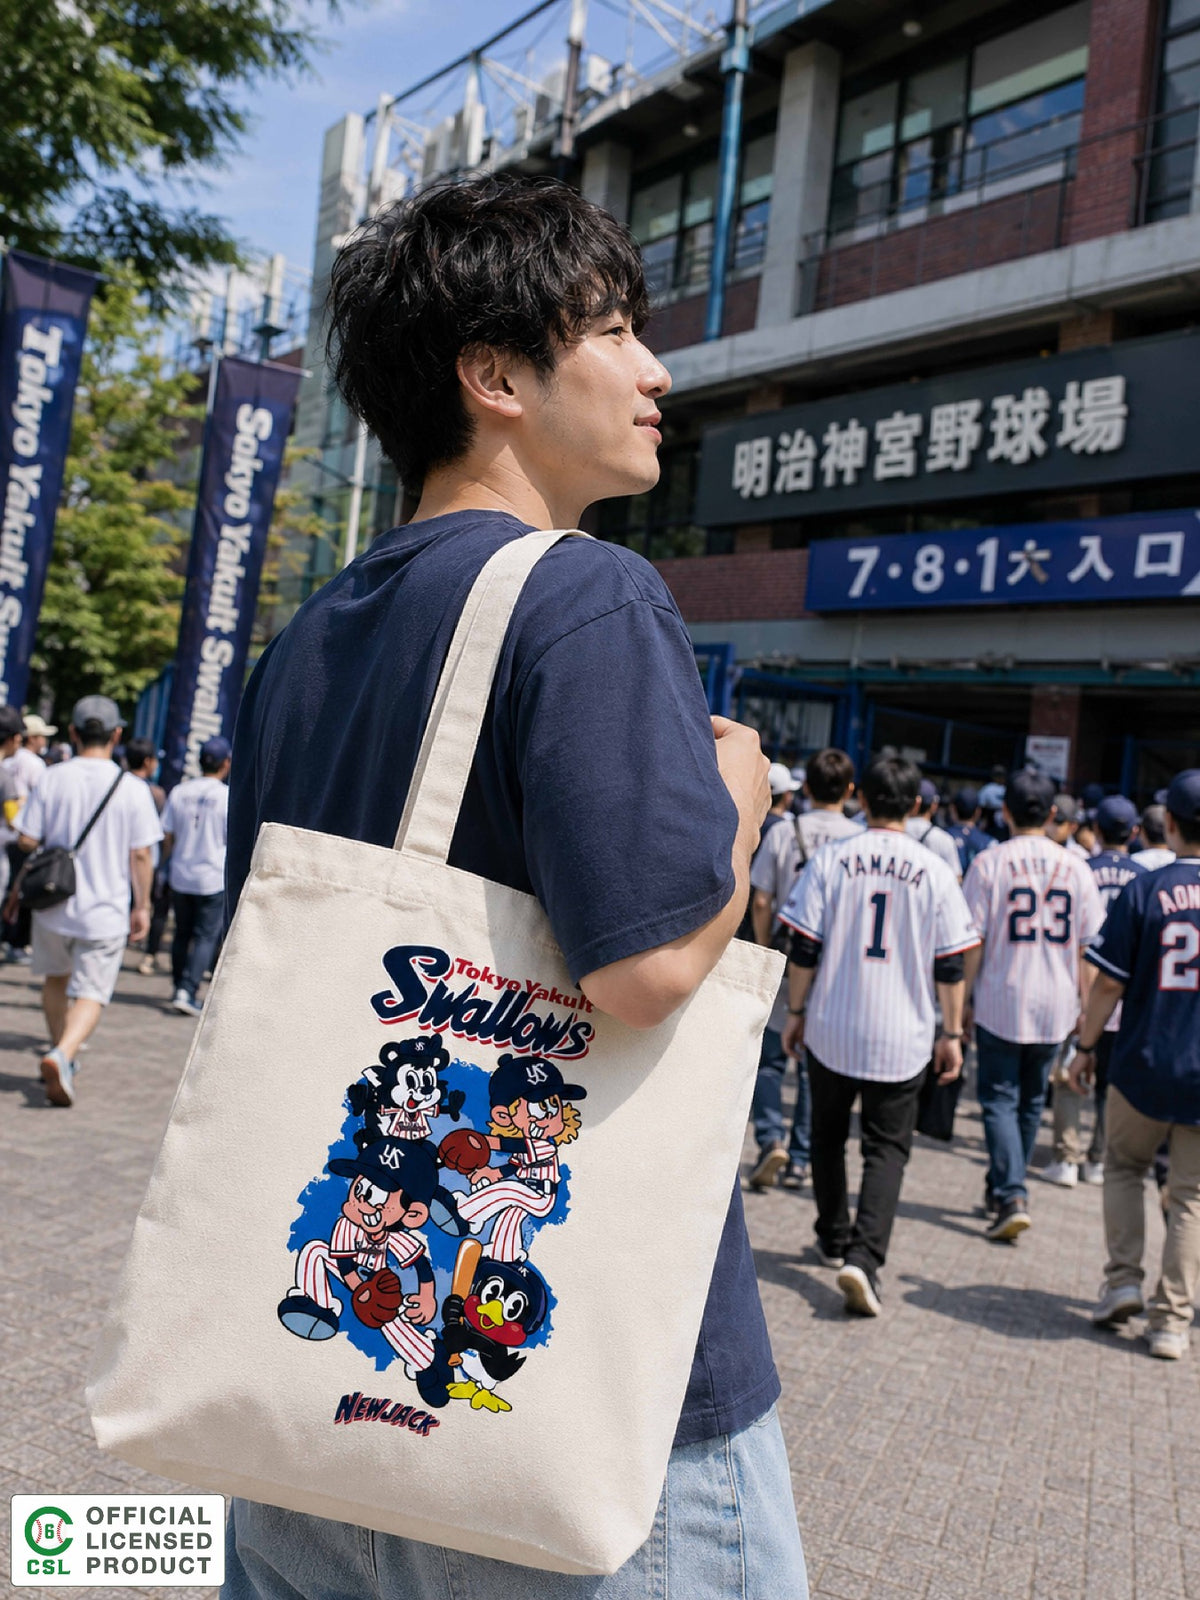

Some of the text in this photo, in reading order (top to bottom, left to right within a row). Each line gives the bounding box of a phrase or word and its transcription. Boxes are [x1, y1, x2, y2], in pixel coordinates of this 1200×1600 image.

[11, 322, 63, 458] Tokyo
[733, 375, 1129, 499] 明治神宮野球場
[0, 463, 43, 591] Yakult
[205, 522, 253, 634] Yakult
[840, 853, 926, 889] YAMADA
[1007, 887, 1072, 944] 23
[864, 890, 893, 962] 1
[1158, 921, 1200, 991] 2
[369, 944, 596, 1061] Swallows
[455, 957, 593, 1014] Tokyo Yakult
